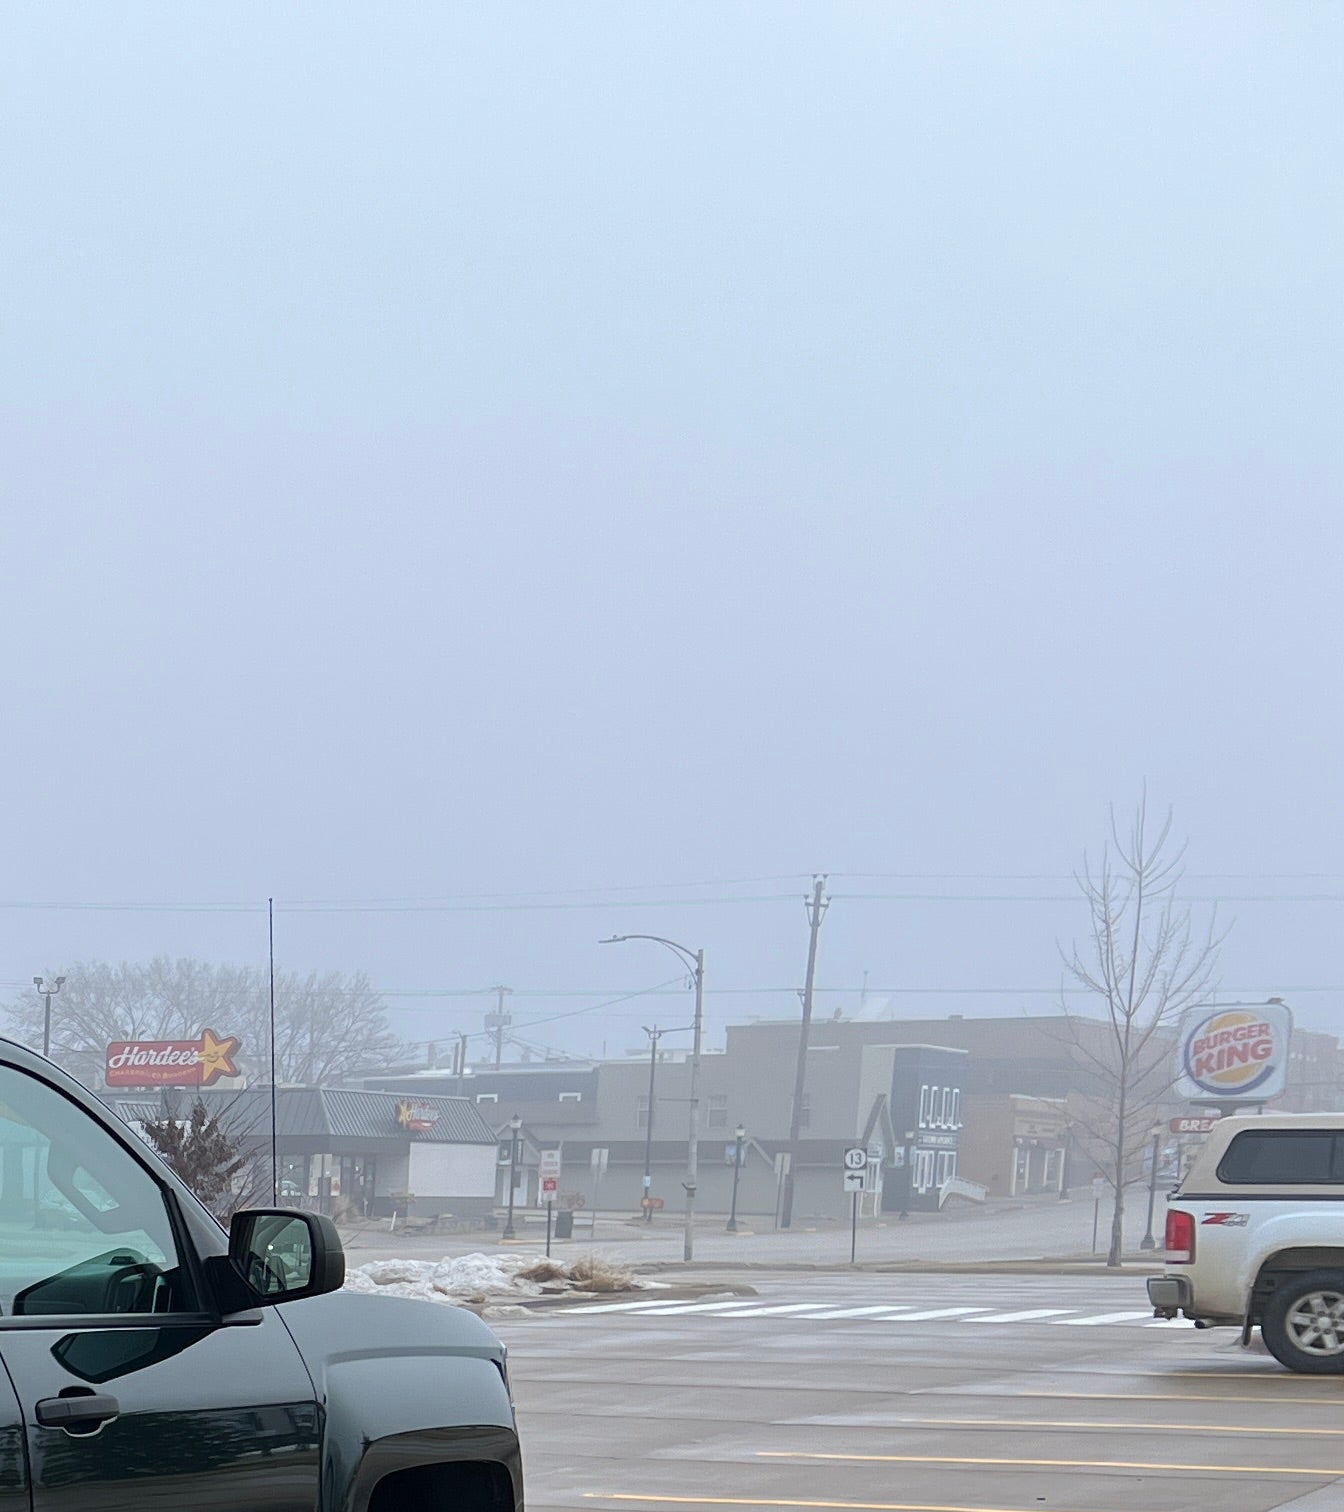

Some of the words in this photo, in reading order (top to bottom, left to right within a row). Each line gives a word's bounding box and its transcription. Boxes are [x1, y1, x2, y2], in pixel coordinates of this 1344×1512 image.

[1193, 1023, 1271, 1057] BURGER
[108, 1046, 199, 1069] Hardee's
[1195, 1039, 1273, 1080] KING
[849, 1152, 862, 1165] 13
